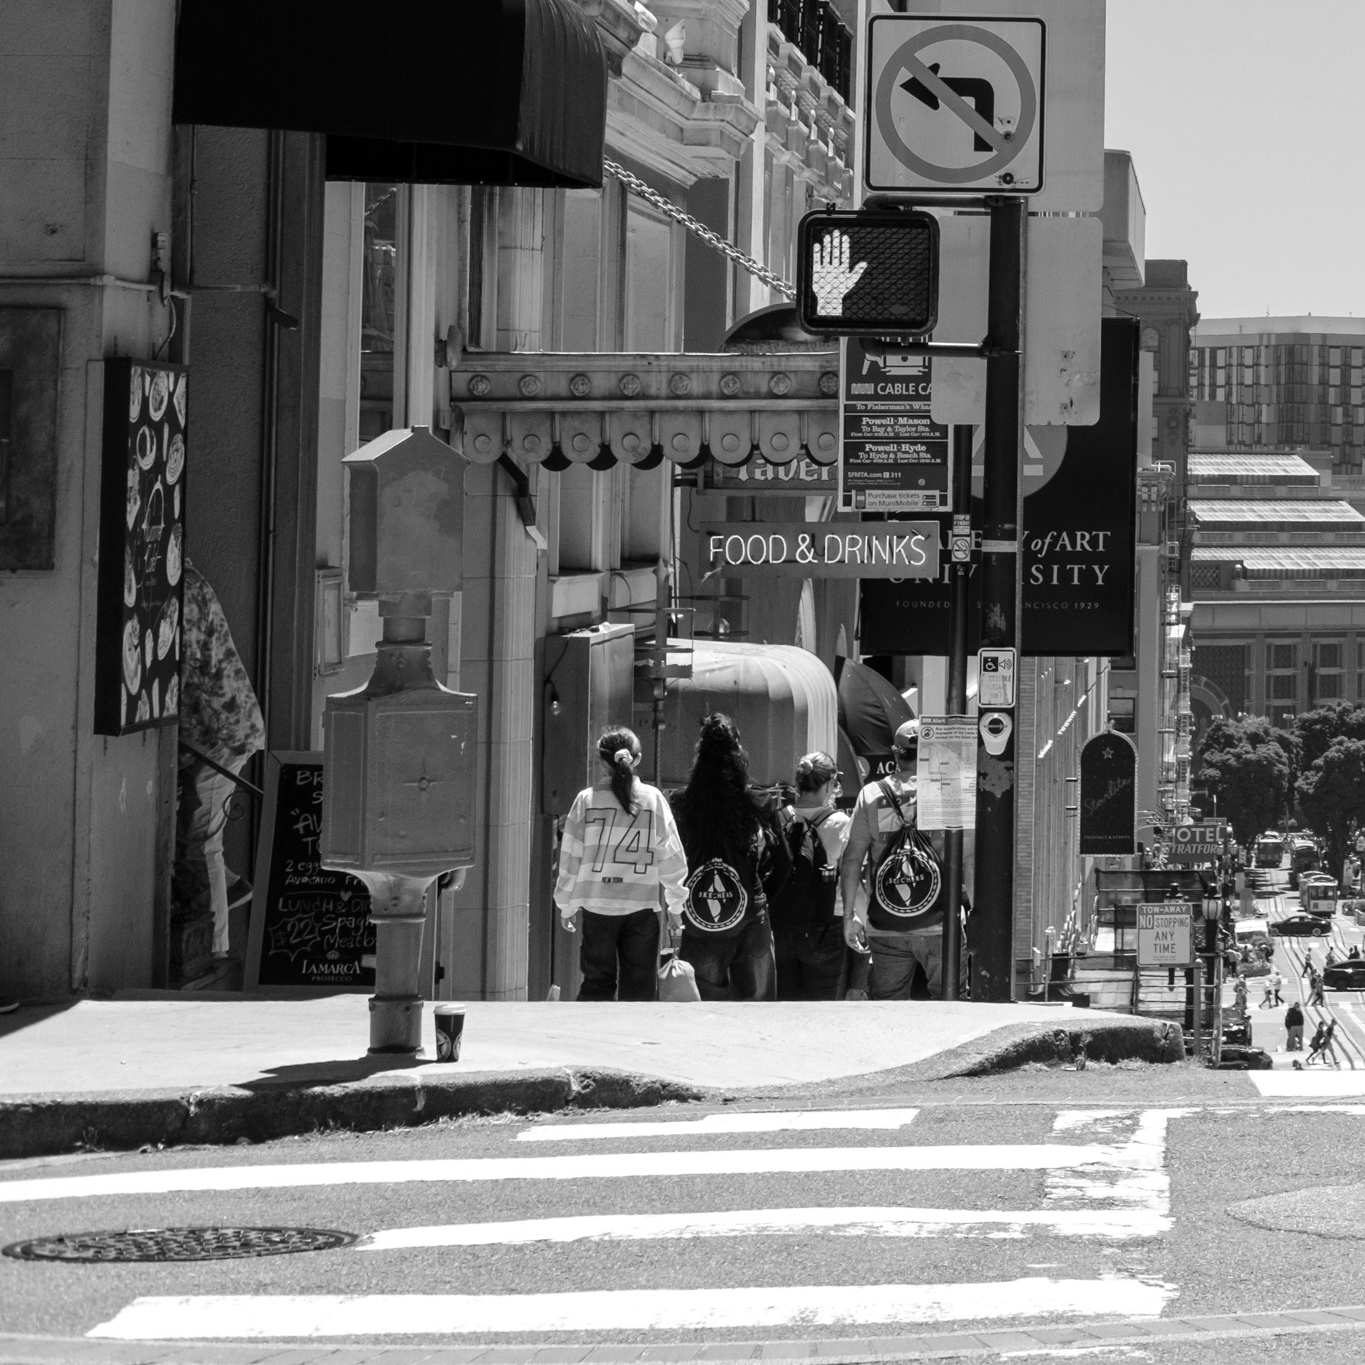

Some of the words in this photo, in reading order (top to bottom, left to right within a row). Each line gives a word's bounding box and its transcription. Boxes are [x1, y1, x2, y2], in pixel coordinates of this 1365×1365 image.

[877, 382, 916, 395] CABLE
[917, 382, 932, 395] CA
[861, 425, 871, 433] To
[872, 425, 885, 434] Bay
[886, 425, 893, 433] &
[894, 425, 916, 434] Taylor
[869, 452, 888, 460] Hyde
[737, 458, 838, 482] aver
[847, 471, 883, 479] SFMTA.com
[867, 492, 897, 500] Purchase
[1055, 530, 1111, 552] ART
[709, 534, 787, 565] FOOD
[795, 533, 818, 564] &
[823, 534, 926, 566] DRINKS
[895, 600, 951, 609] FOUNDED
[1025, 601, 1069, 610] NCISCO
[1073, 601, 1100, 610] 1929
[585, 807, 655, 875] 74
[1171, 843, 1218, 855] TRATFOR
[285, 859, 294, 873] 2
[297, 861, 321, 876] egg
[1142, 905, 1188, 913] TOW-AWAY
[320, 914, 374, 936] Spagh
[1139, 915, 1154, 928] NO
[1155, 916, 1189, 929] STOPPING
[323, 933, 376, 951] Meatb
[1154, 931, 1175, 942] ANY
[1153, 943, 1177, 954] TIME
